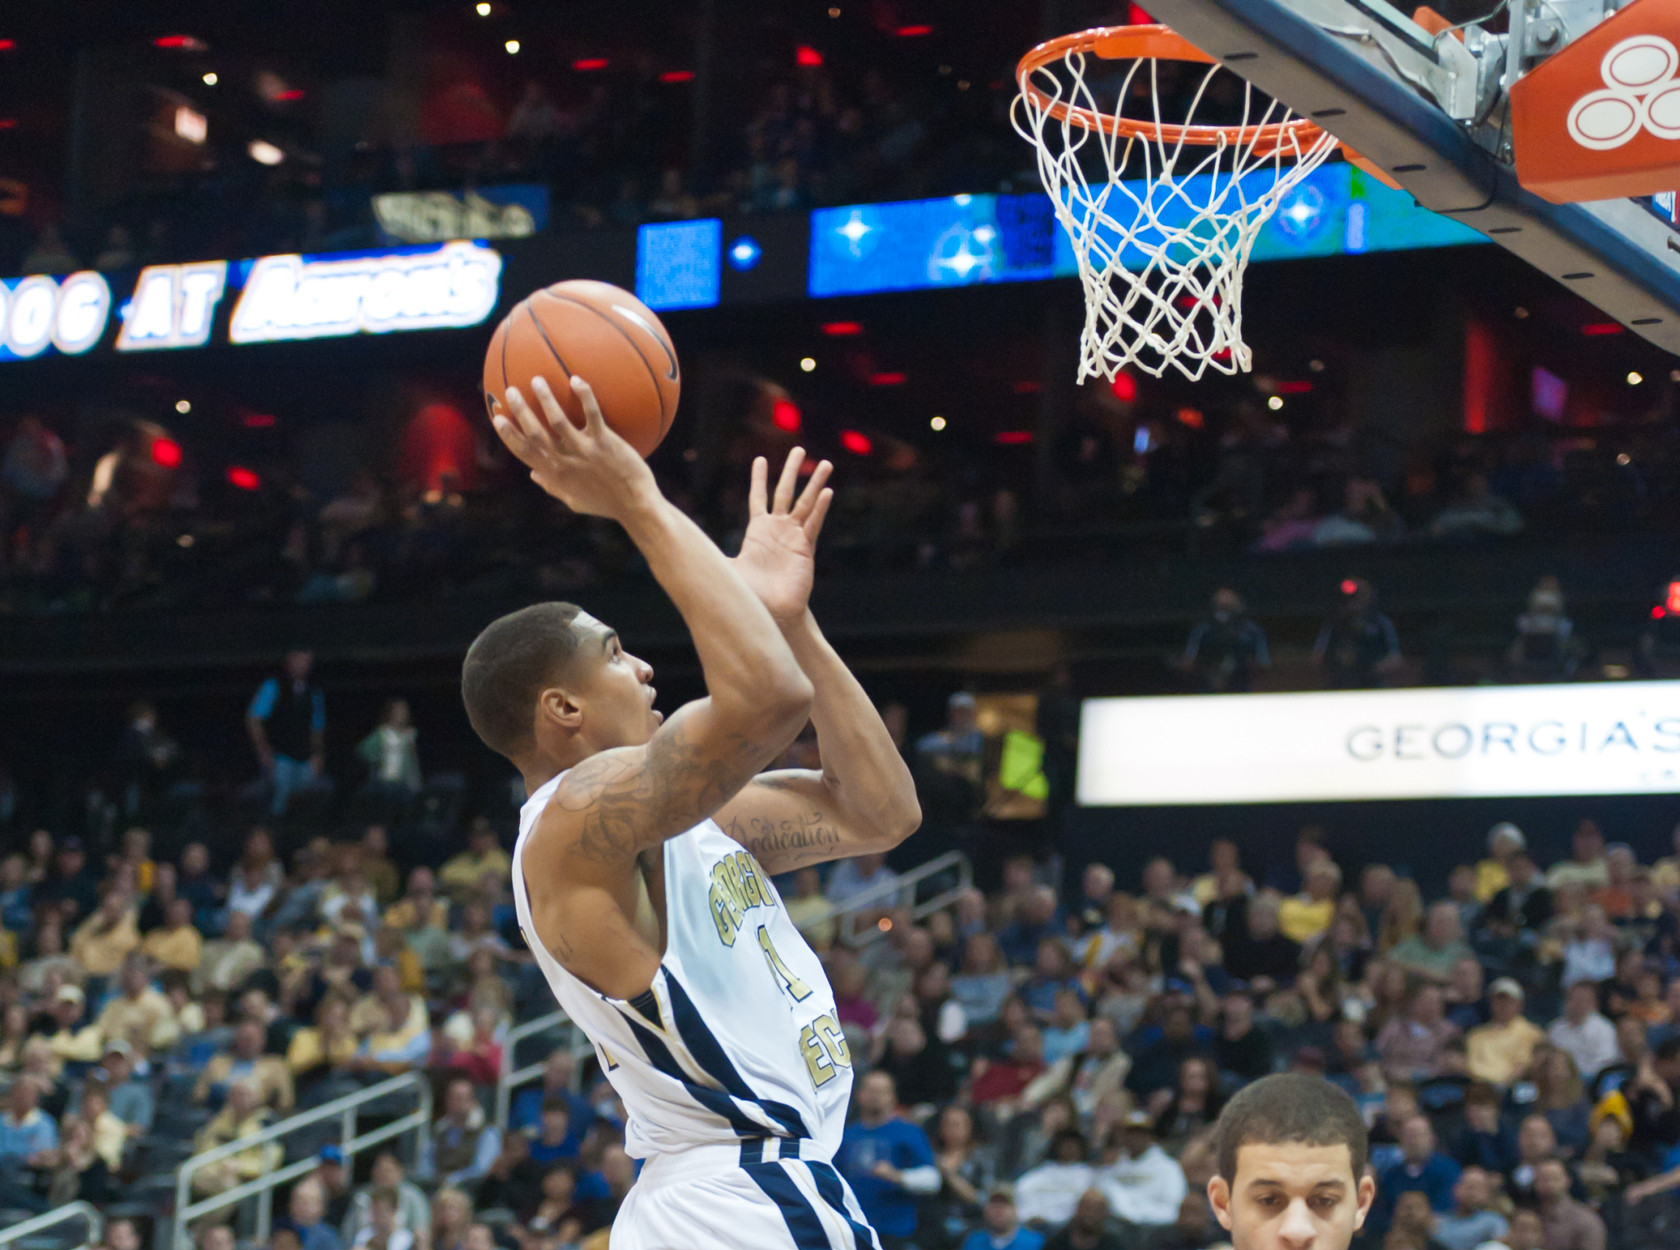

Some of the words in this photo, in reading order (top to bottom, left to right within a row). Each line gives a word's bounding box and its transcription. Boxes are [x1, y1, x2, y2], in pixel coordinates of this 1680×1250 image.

[0, 270, 112, 358] OG
[114, 260, 228, 351] AT
[229, 240, 502, 345] Aaron's
[708, 850, 780, 948] GEORGI
[757, 924, 814, 1003] 1
